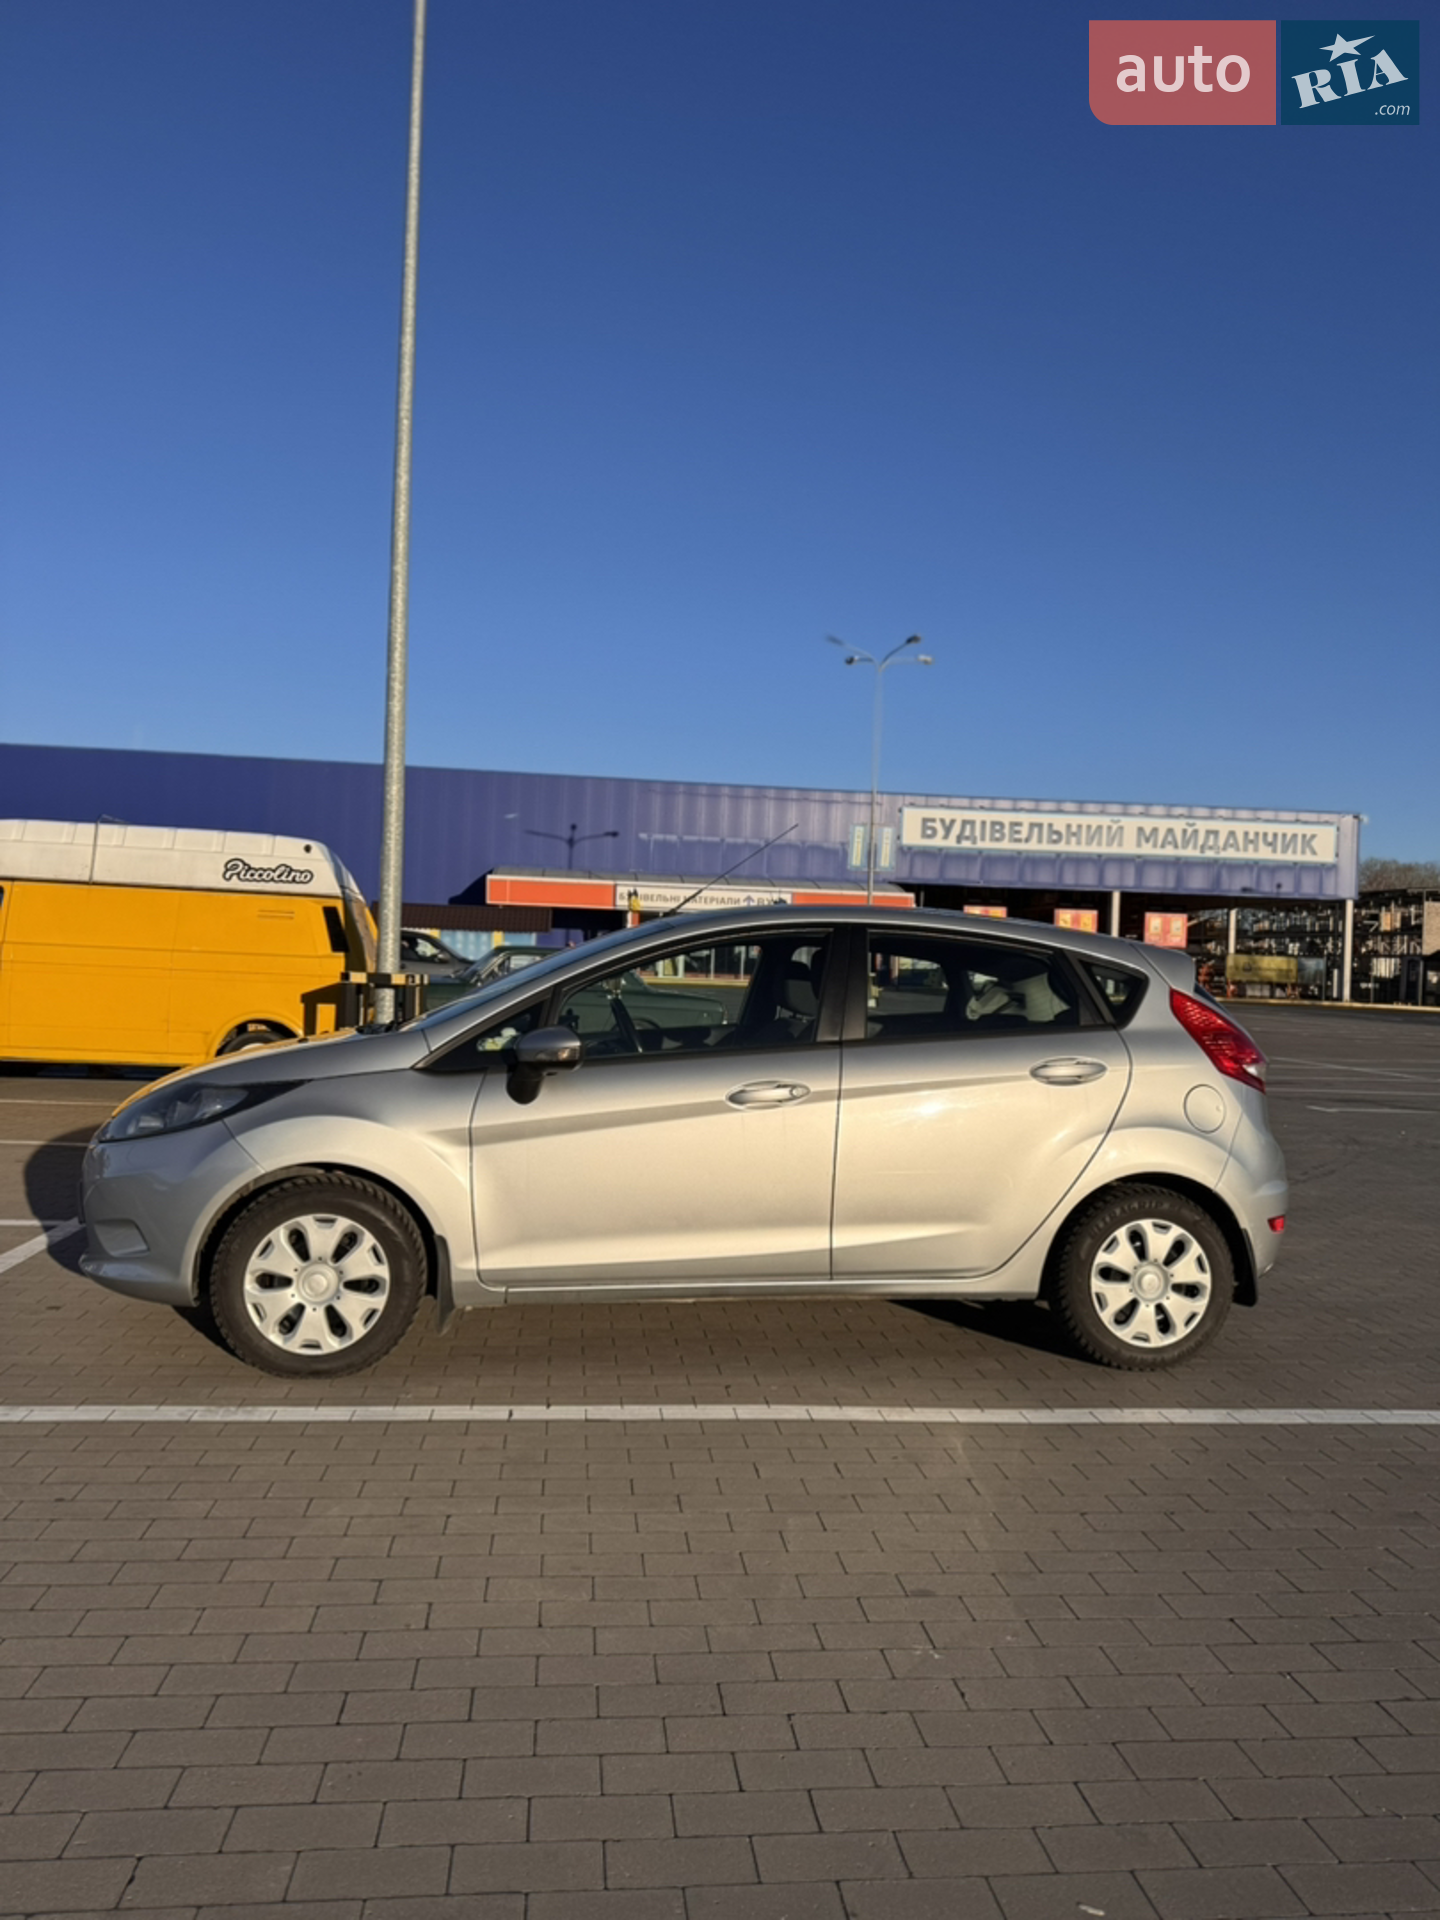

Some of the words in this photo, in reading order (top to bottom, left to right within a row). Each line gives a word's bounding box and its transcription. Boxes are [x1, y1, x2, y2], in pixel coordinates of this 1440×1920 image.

[920, 817, 1124, 848] БУДІВЕЛЬНИЙ
[1136, 822, 1318, 856] МАЙДАНЧИК
[222, 858, 314, 884] Piccolino
